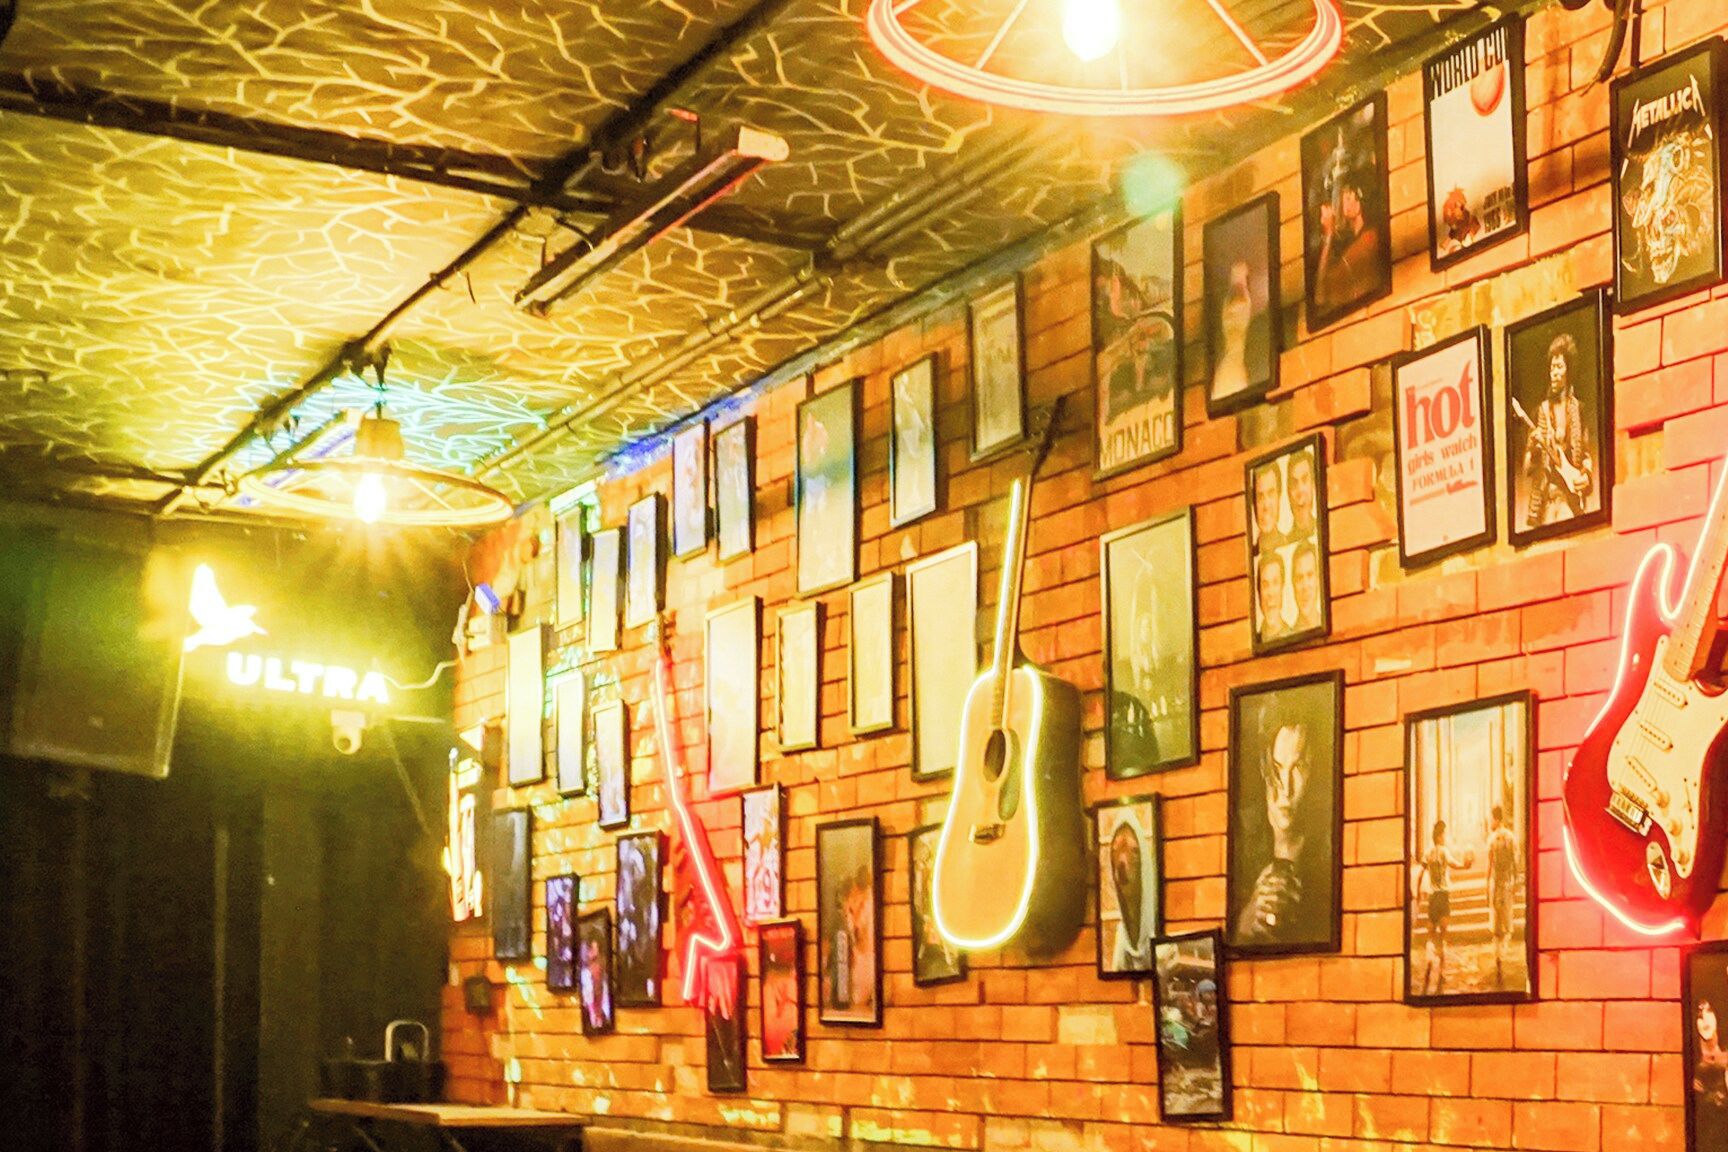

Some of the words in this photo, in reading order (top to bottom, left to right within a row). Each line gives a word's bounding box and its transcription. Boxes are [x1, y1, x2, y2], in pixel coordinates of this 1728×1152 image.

[1430, 42, 1479, 98] WORLD
[1628, 74, 1705, 148] METALLICA
[1405, 361, 1475, 451] hot
[1407, 449, 1435, 475] girls
[1441, 432, 1477, 460] watch
[1412, 461, 1464, 491] FORMULA
[226, 651, 390, 704] ULTRA
